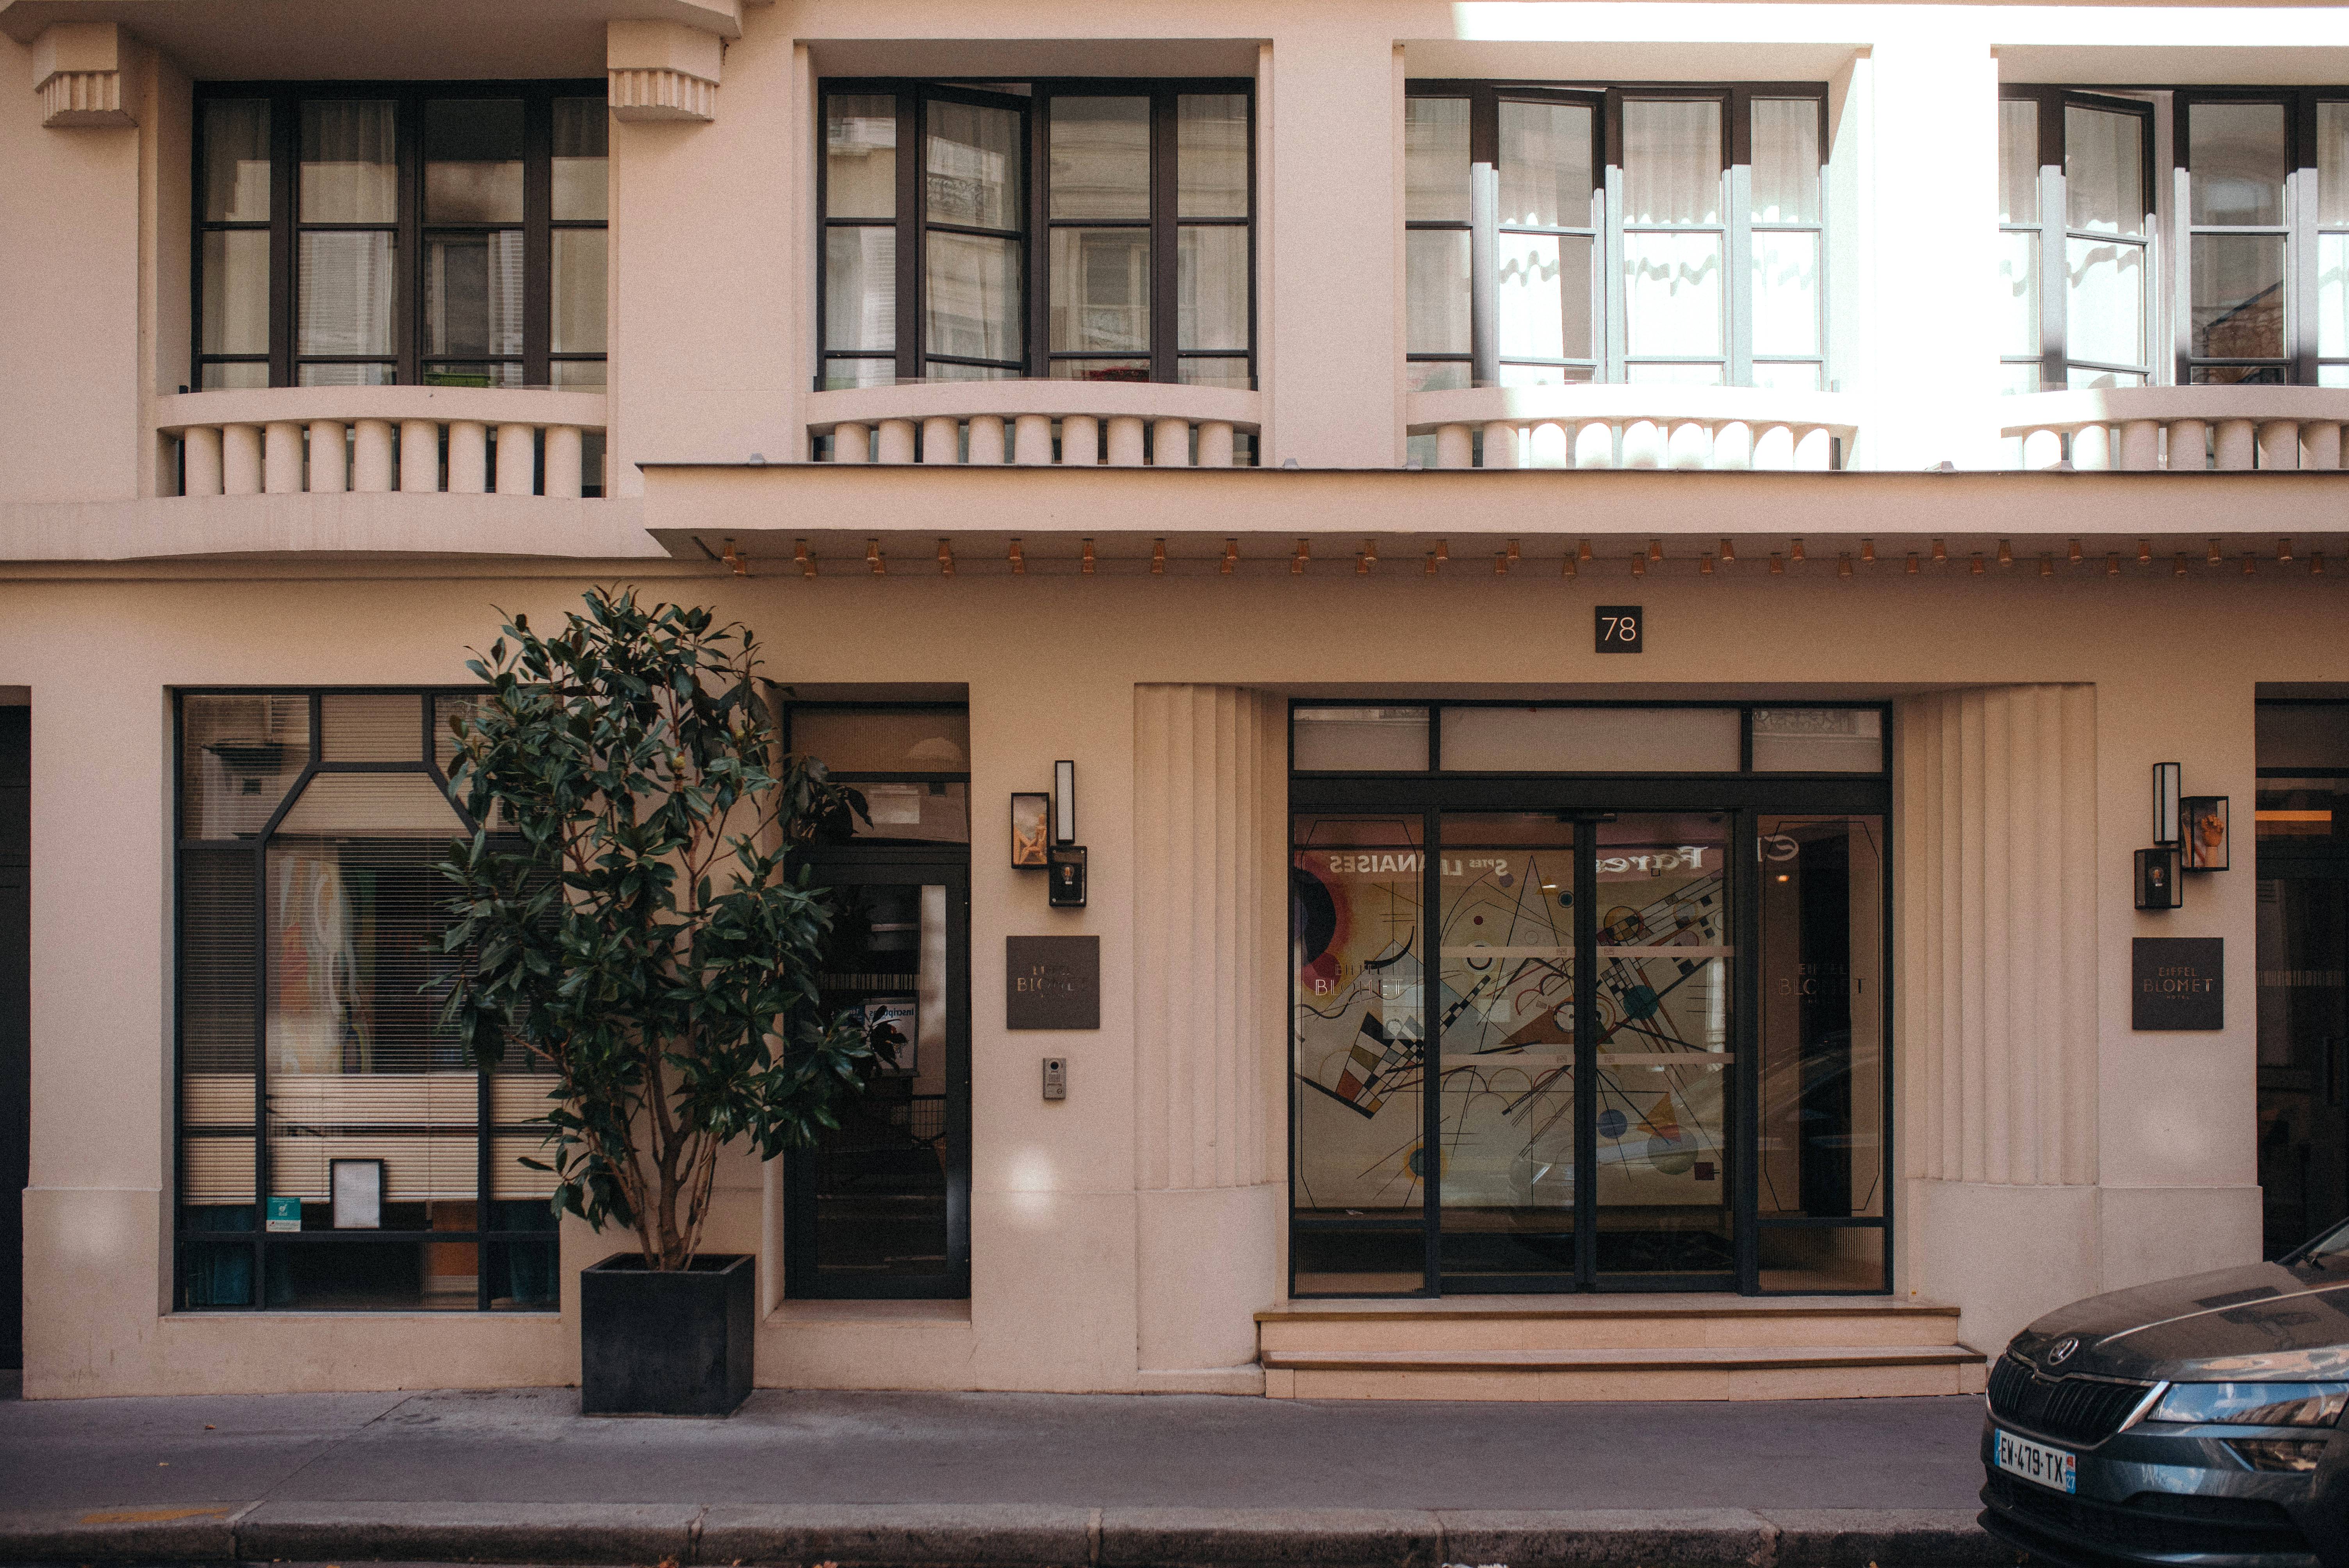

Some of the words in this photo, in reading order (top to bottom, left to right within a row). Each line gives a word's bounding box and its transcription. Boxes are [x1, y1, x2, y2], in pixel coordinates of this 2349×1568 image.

[1602, 617, 1636, 641] 78
[1798, 963, 1847, 975] EIEL
[2158, 967, 2198, 976] EIFFEL
[1315, 979, 1403, 996] BLOMET
[1779, 978, 1866, 995] BLOT
[2143, 979, 2213, 992] BLOMET
[2001, 1437, 2063, 1484] EW-479-TX
[2066, 1475, 2075, 1490] 27
